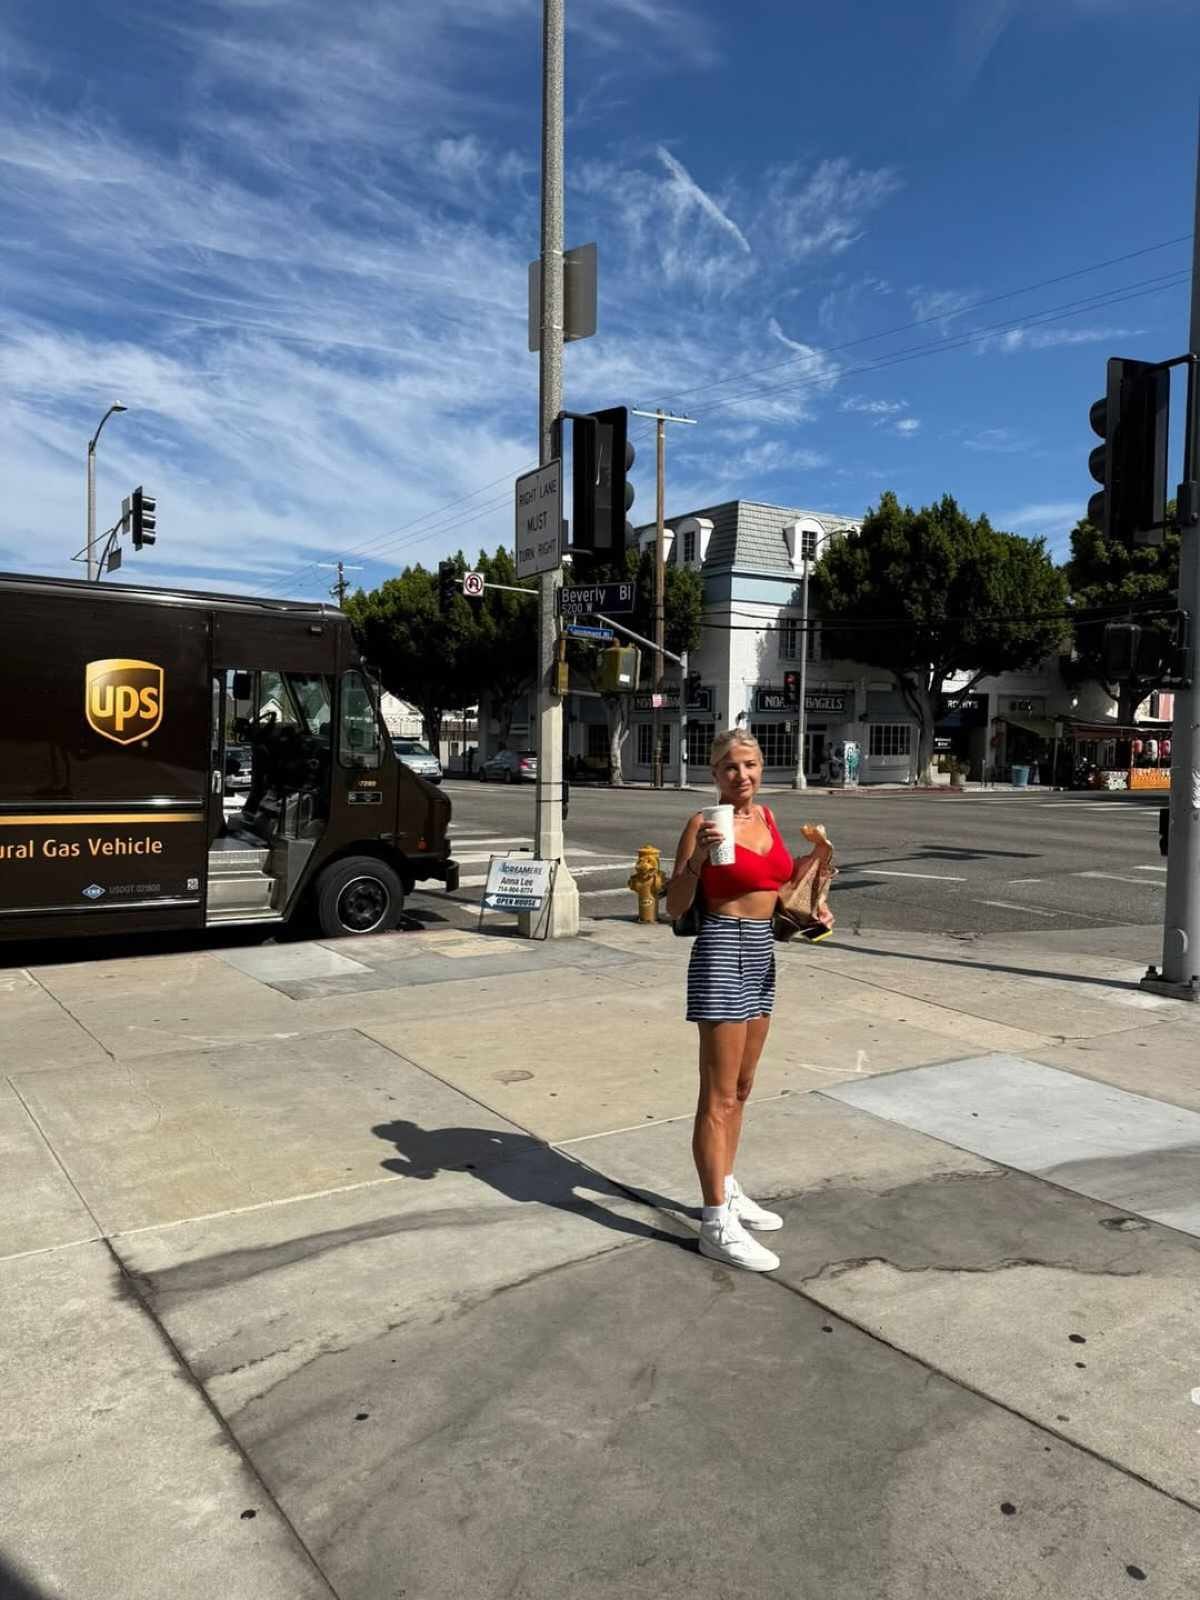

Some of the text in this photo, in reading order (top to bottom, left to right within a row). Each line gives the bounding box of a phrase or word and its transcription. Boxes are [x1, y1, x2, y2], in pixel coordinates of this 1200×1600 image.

[519, 480, 557, 505] RIGHT LANE
[527, 511, 547, 531] MUST
[519, 539, 557, 564] TURN RIGHT
[561, 585, 631, 605] Beverly Bl
[91, 685, 158, 731] ups
[42, 839, 81, 858] Gas
[88, 836, 163, 856] Vehicle
[501, 877, 533, 886] Anna Lee
